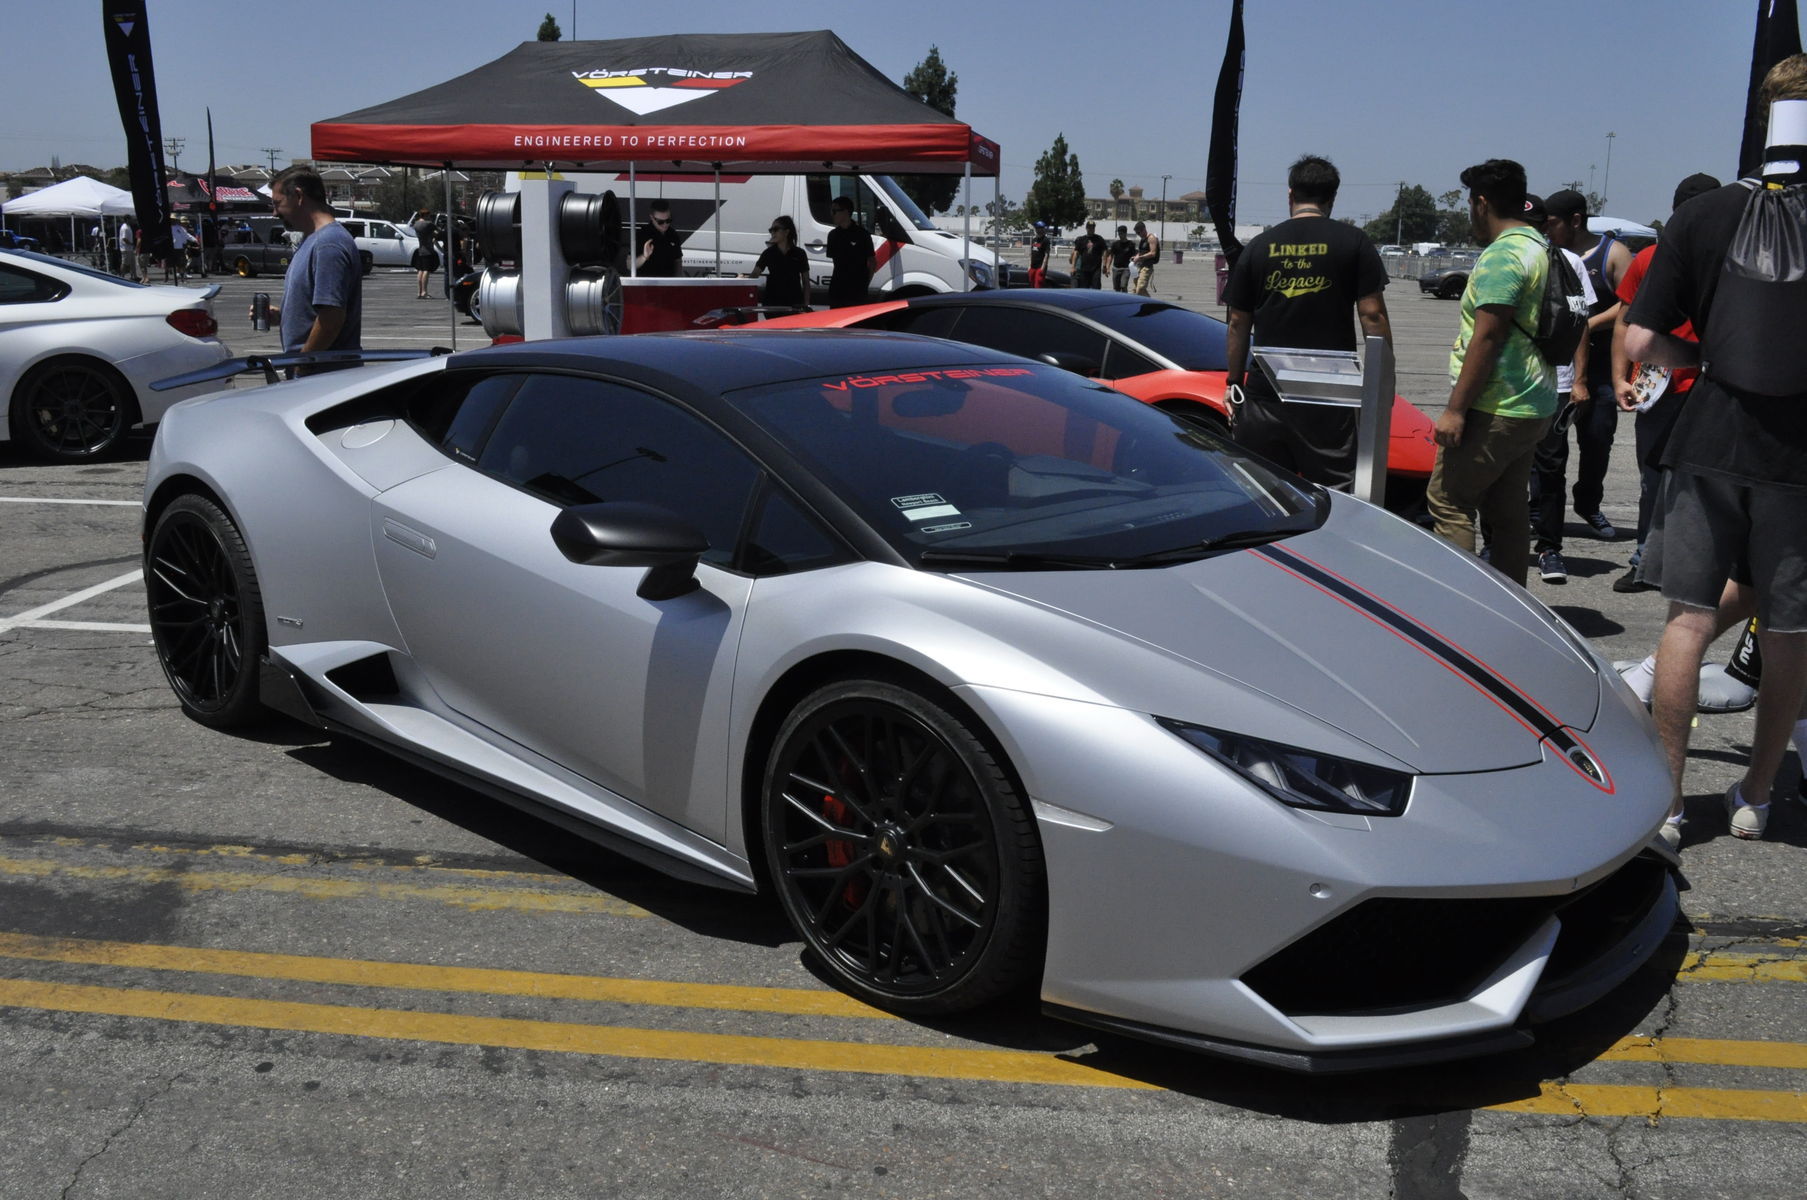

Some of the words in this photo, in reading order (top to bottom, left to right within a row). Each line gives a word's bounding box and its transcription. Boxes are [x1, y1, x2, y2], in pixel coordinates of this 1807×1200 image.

[572, 67, 753, 79] VÖRSTEINER
[514, 135, 613, 147] ENGINEERED
[621, 135, 639, 147] TO
[647, 135, 747, 147] PERFECTION
[1281, 258, 1294, 269] to
[1294, 257, 1312, 270] the
[1265, 270, 1333, 294] Legacy
[821, 368, 1036, 391] VÖRSTEINER
